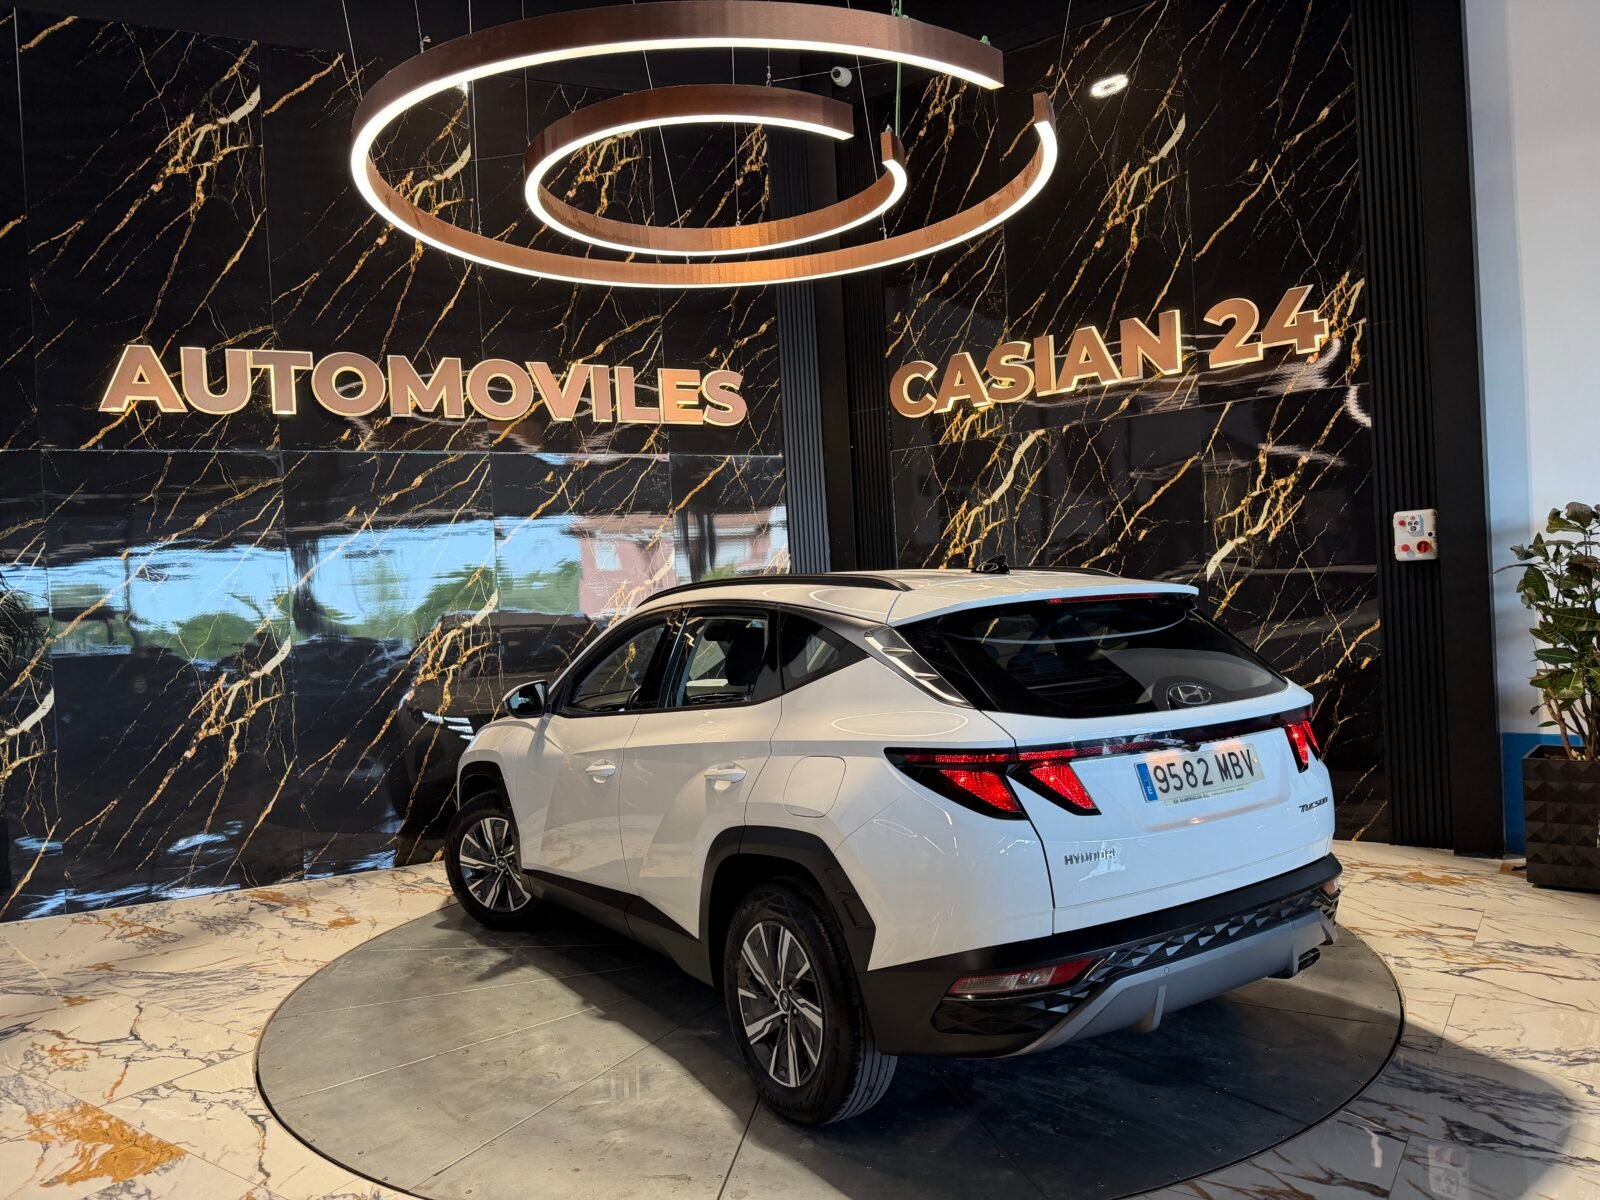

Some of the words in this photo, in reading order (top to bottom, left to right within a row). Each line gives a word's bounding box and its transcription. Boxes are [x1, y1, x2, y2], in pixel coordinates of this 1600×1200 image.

[889, 309, 1182, 418] CASIAN
[1203, 284, 1329, 369] 24
[98, 344, 748, 427] AUTOMOVILES
[1153, 757, 1214, 794] 9582
[1214, 749, 1255, 782] MBV
[1064, 847, 1116, 866] HYUNDAI
